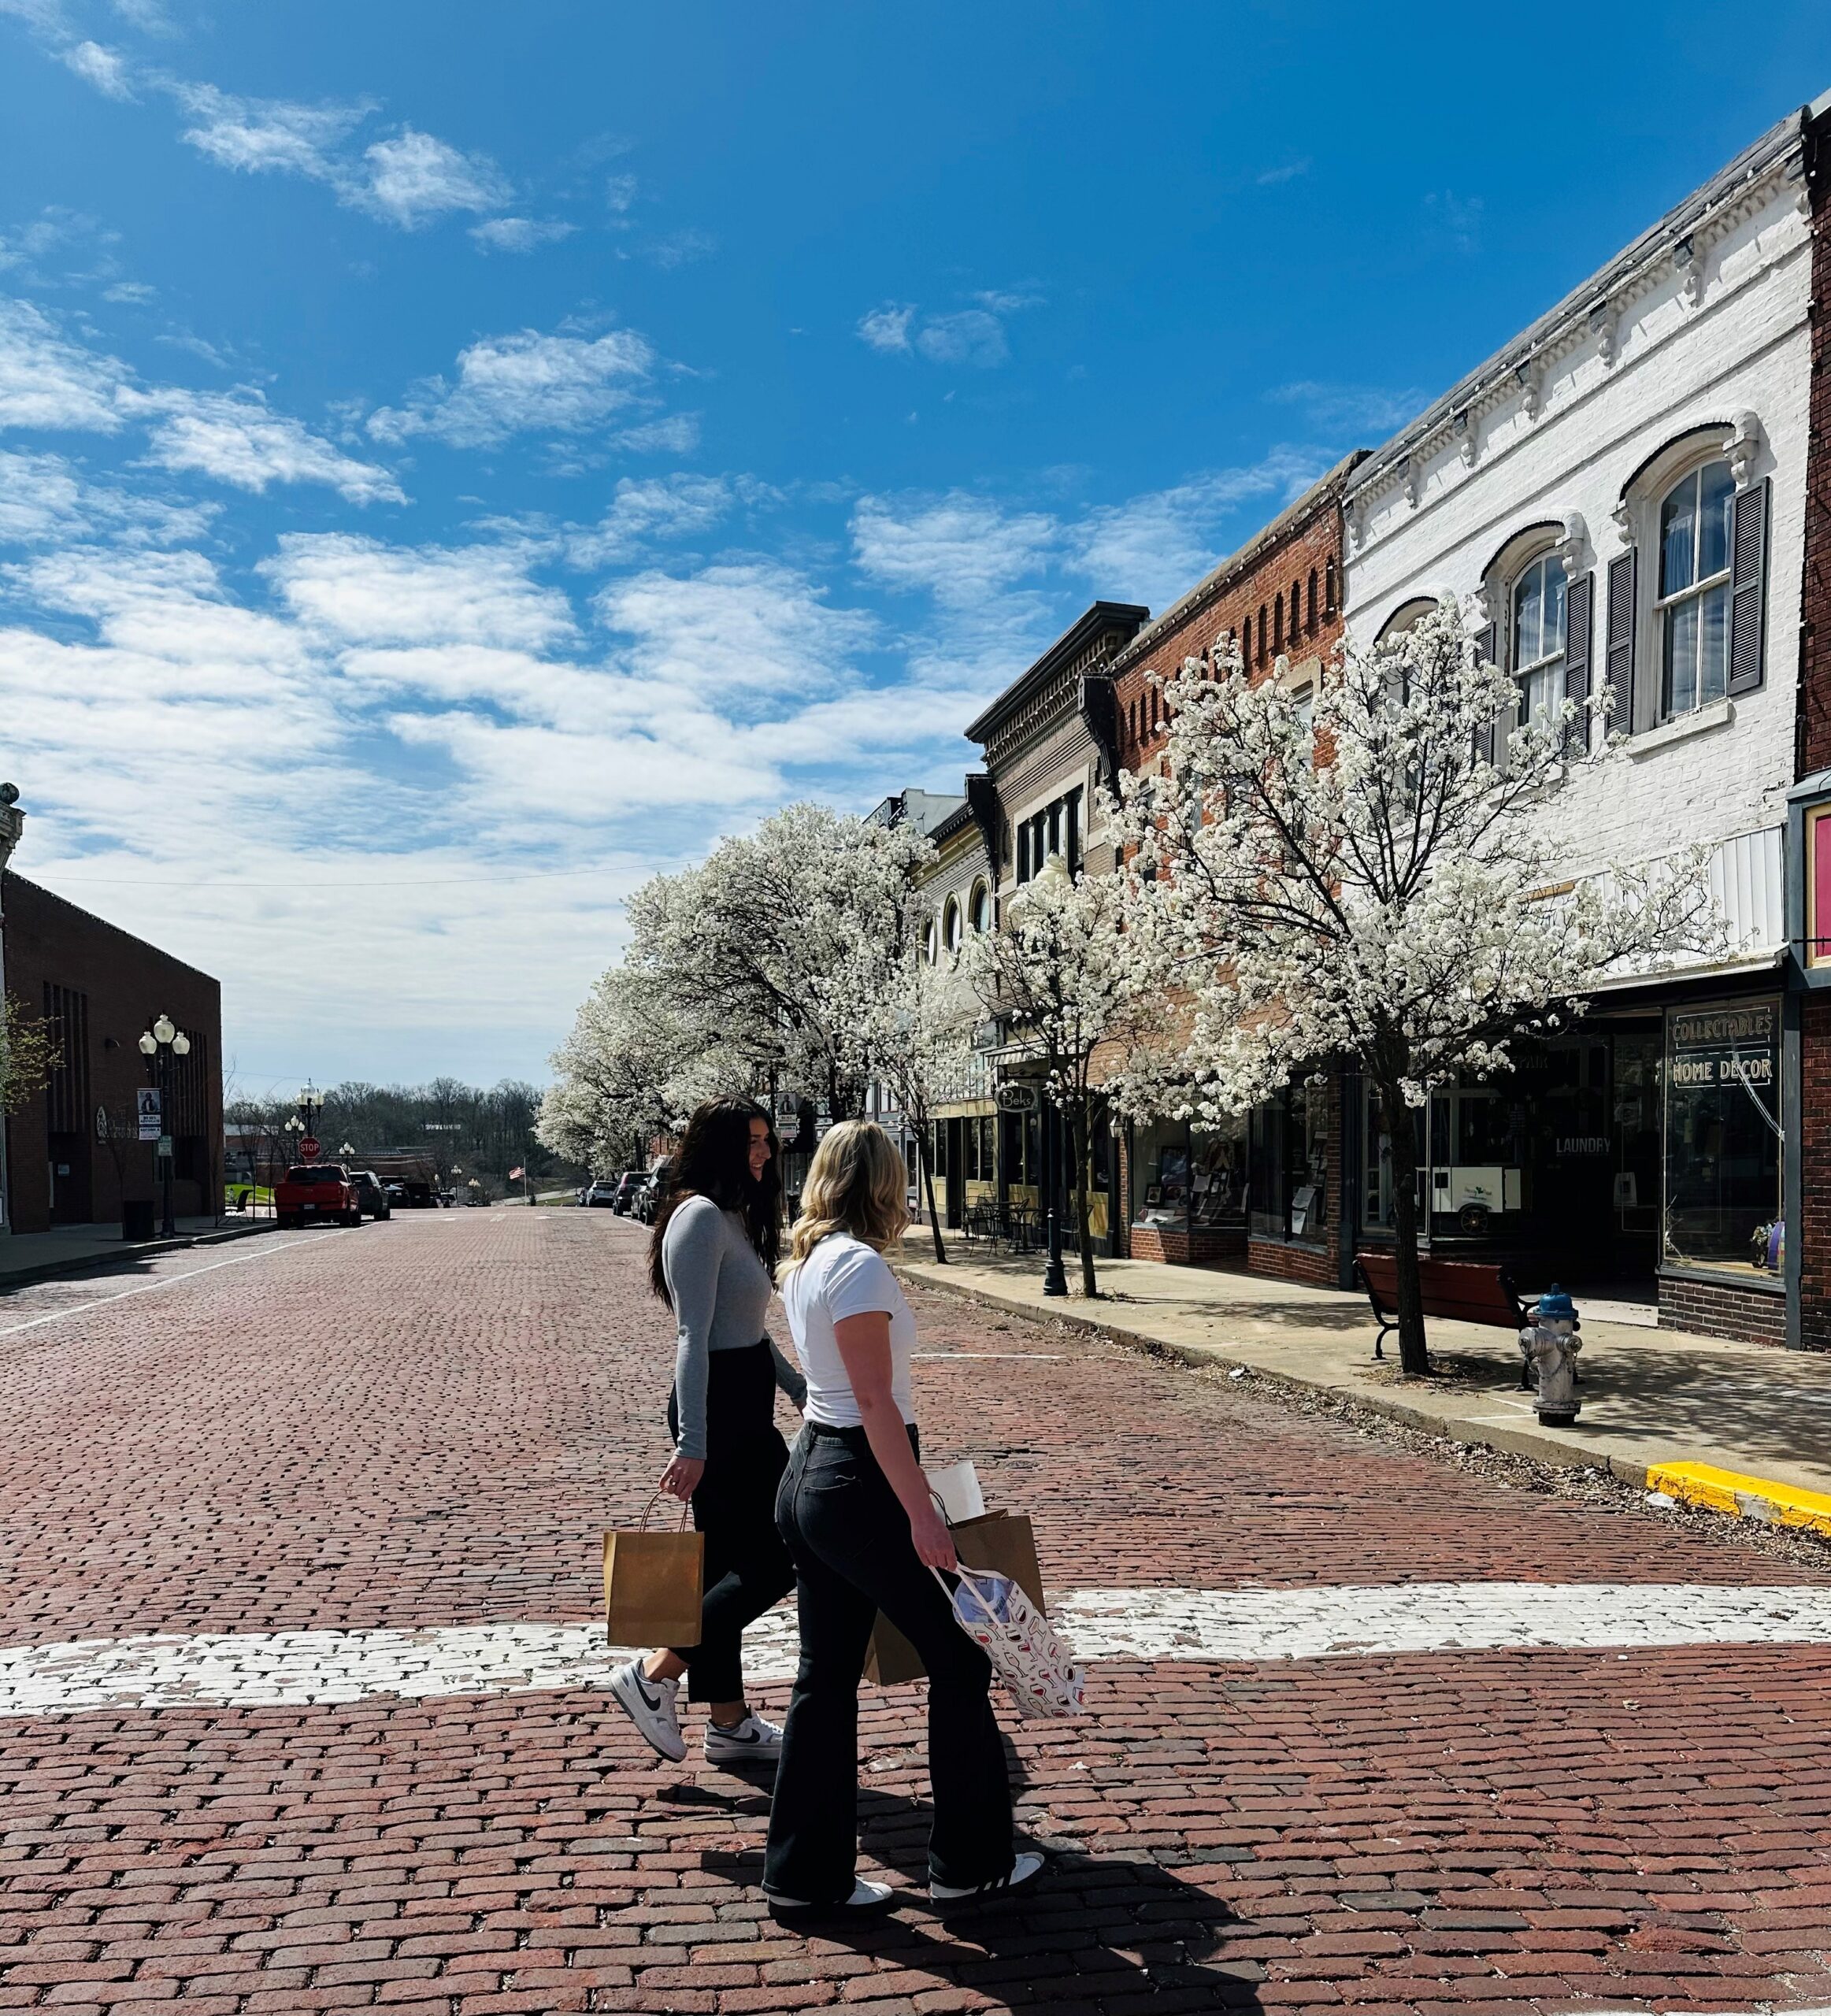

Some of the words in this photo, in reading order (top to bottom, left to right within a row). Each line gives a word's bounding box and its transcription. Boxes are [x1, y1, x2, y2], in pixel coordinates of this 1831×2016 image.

[1673, 1014, 1773, 1041] COLLECTABLES
[1673, 1062, 1714, 1082] HOME
[1720, 1058, 1773, 1080] DECOR
[1002, 1089, 1031, 1106] Beks
[300, 1143, 320, 1152] STOP
[1555, 1137, 1611, 1153] LAUNDRY
